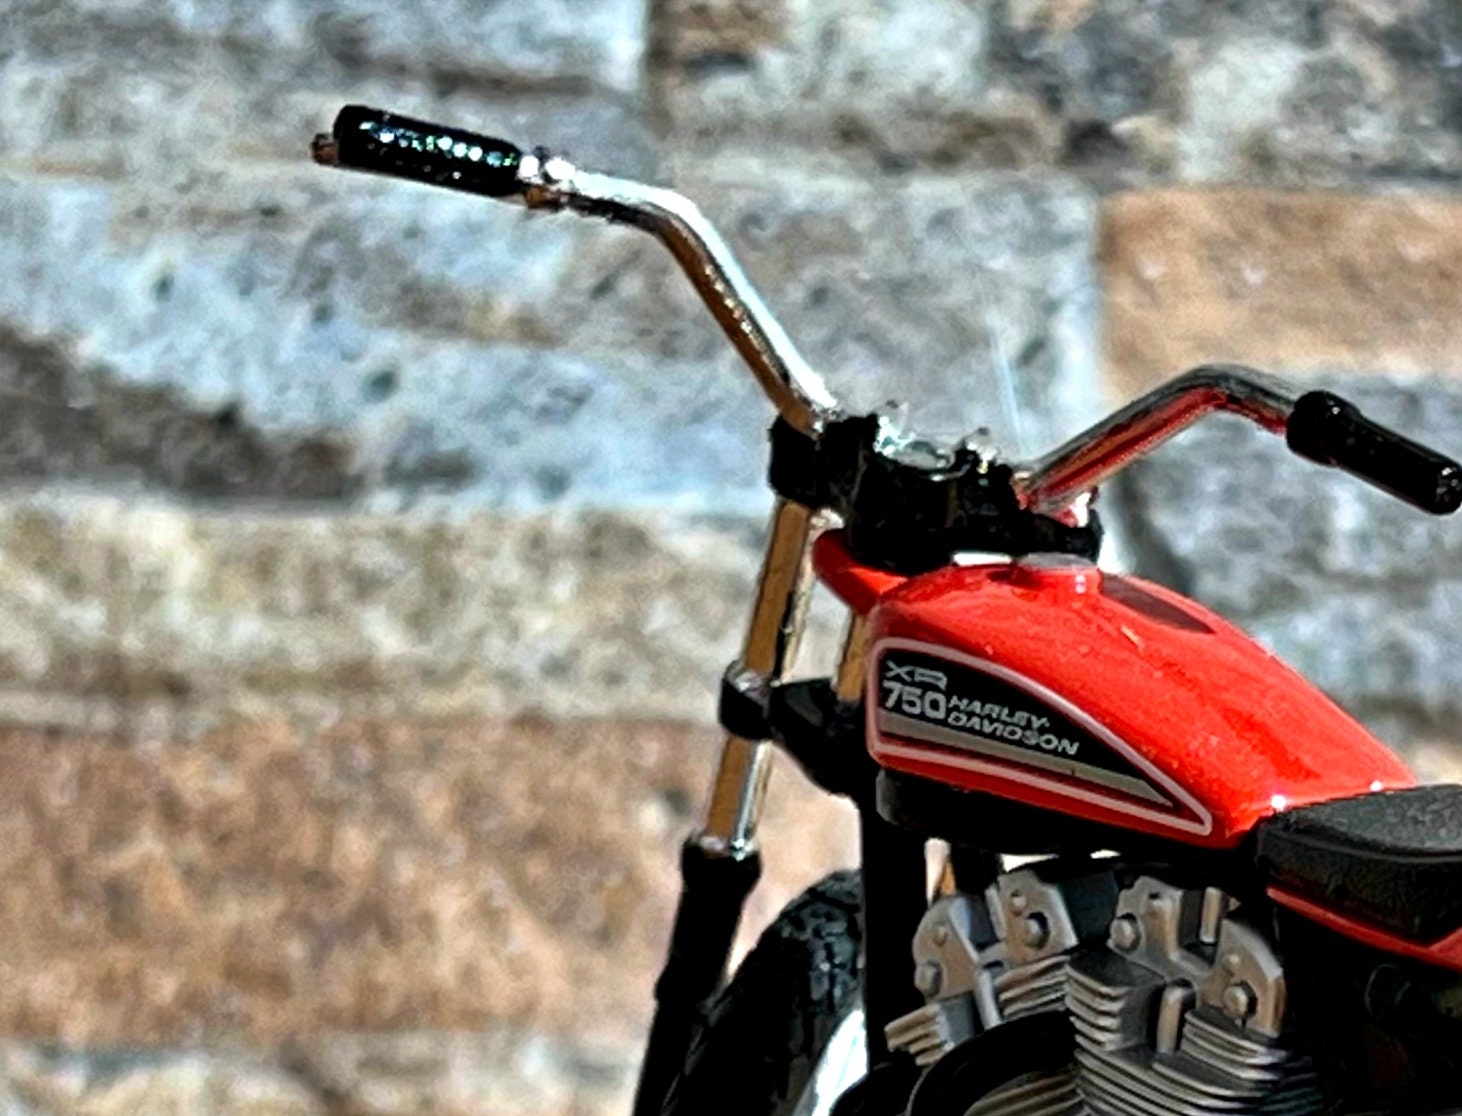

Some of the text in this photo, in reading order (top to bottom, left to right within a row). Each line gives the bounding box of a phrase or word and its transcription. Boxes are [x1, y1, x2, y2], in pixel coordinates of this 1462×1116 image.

[885, 660, 948, 691] XR
[882, 680, 947, 720] 750
[948, 711, 1080, 755] DAVIDSON
